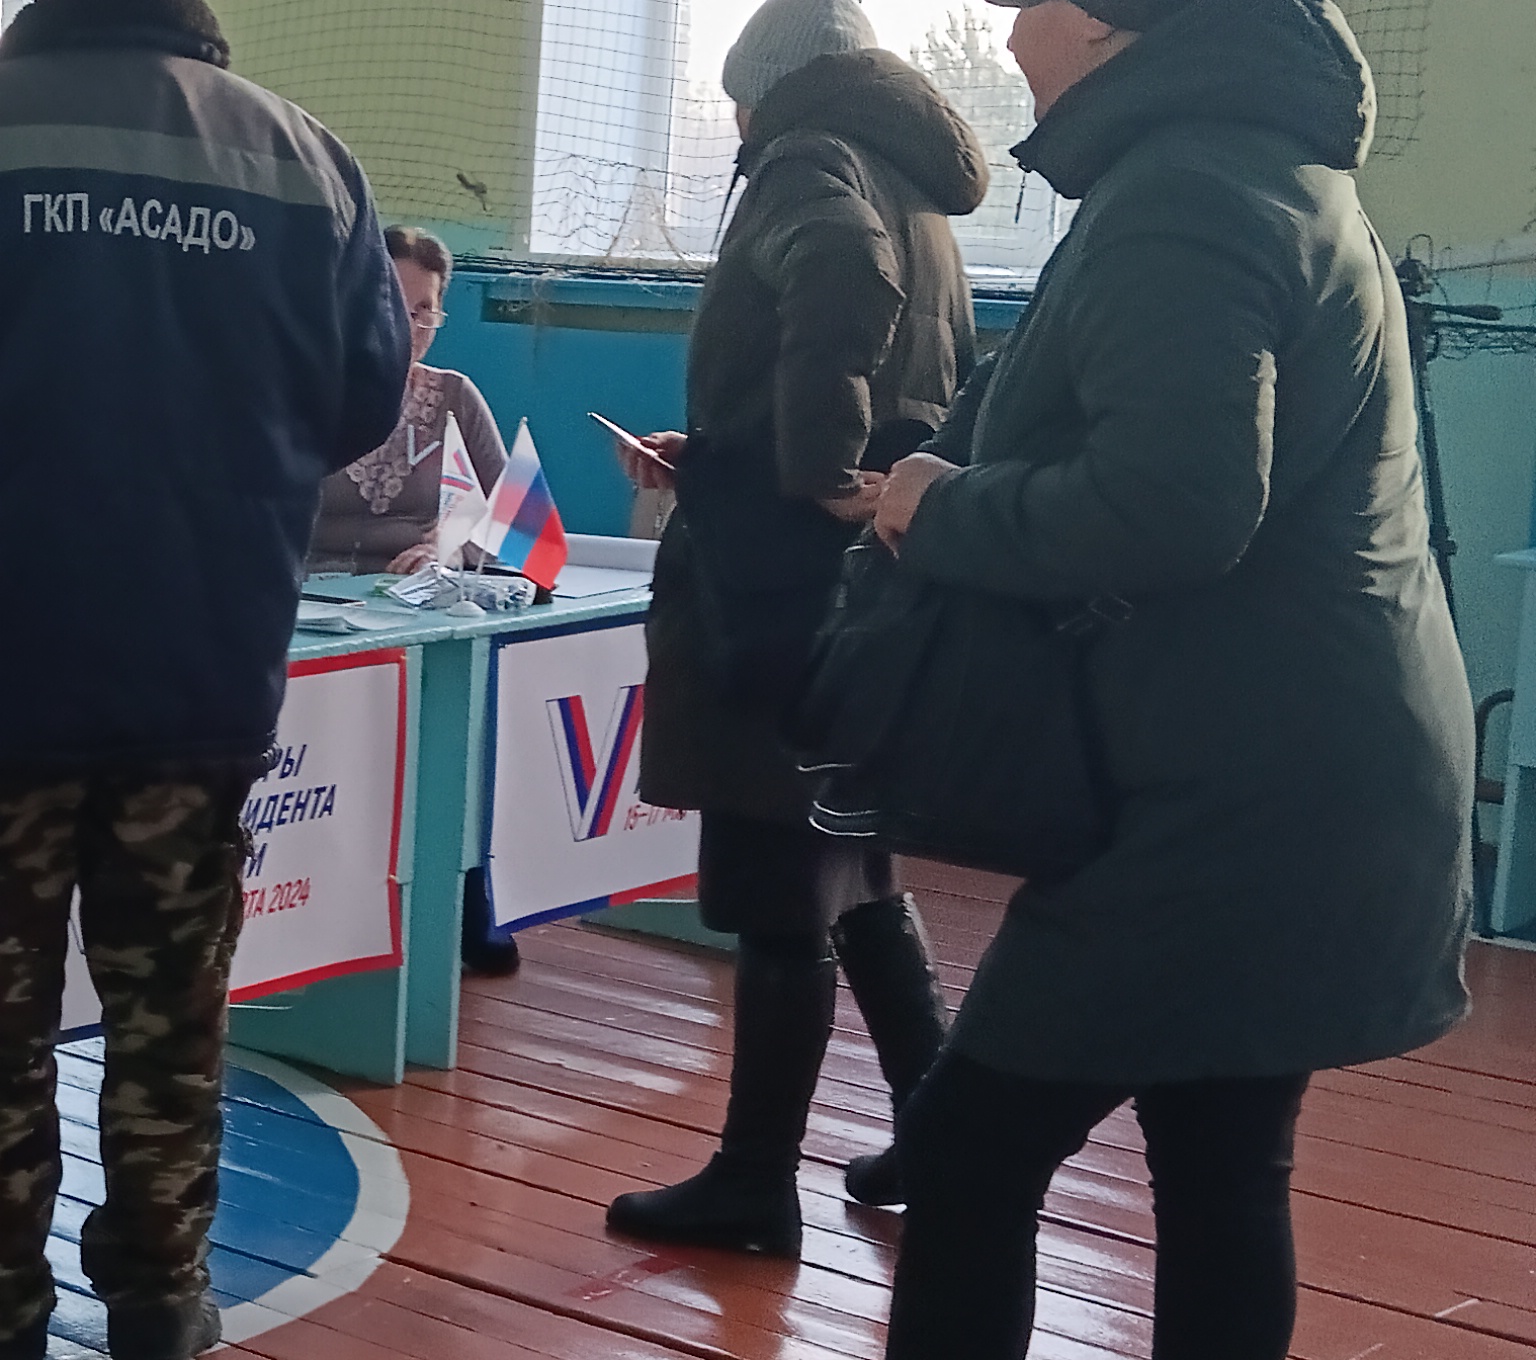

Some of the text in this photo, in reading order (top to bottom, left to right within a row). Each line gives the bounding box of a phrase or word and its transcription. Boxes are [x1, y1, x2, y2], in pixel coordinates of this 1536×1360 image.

[24, 193, 256, 255] ГКП «АСАДО»
[243, 784, 337, 836] ИДЕНТА
[267, 876, 312, 914] 2024
